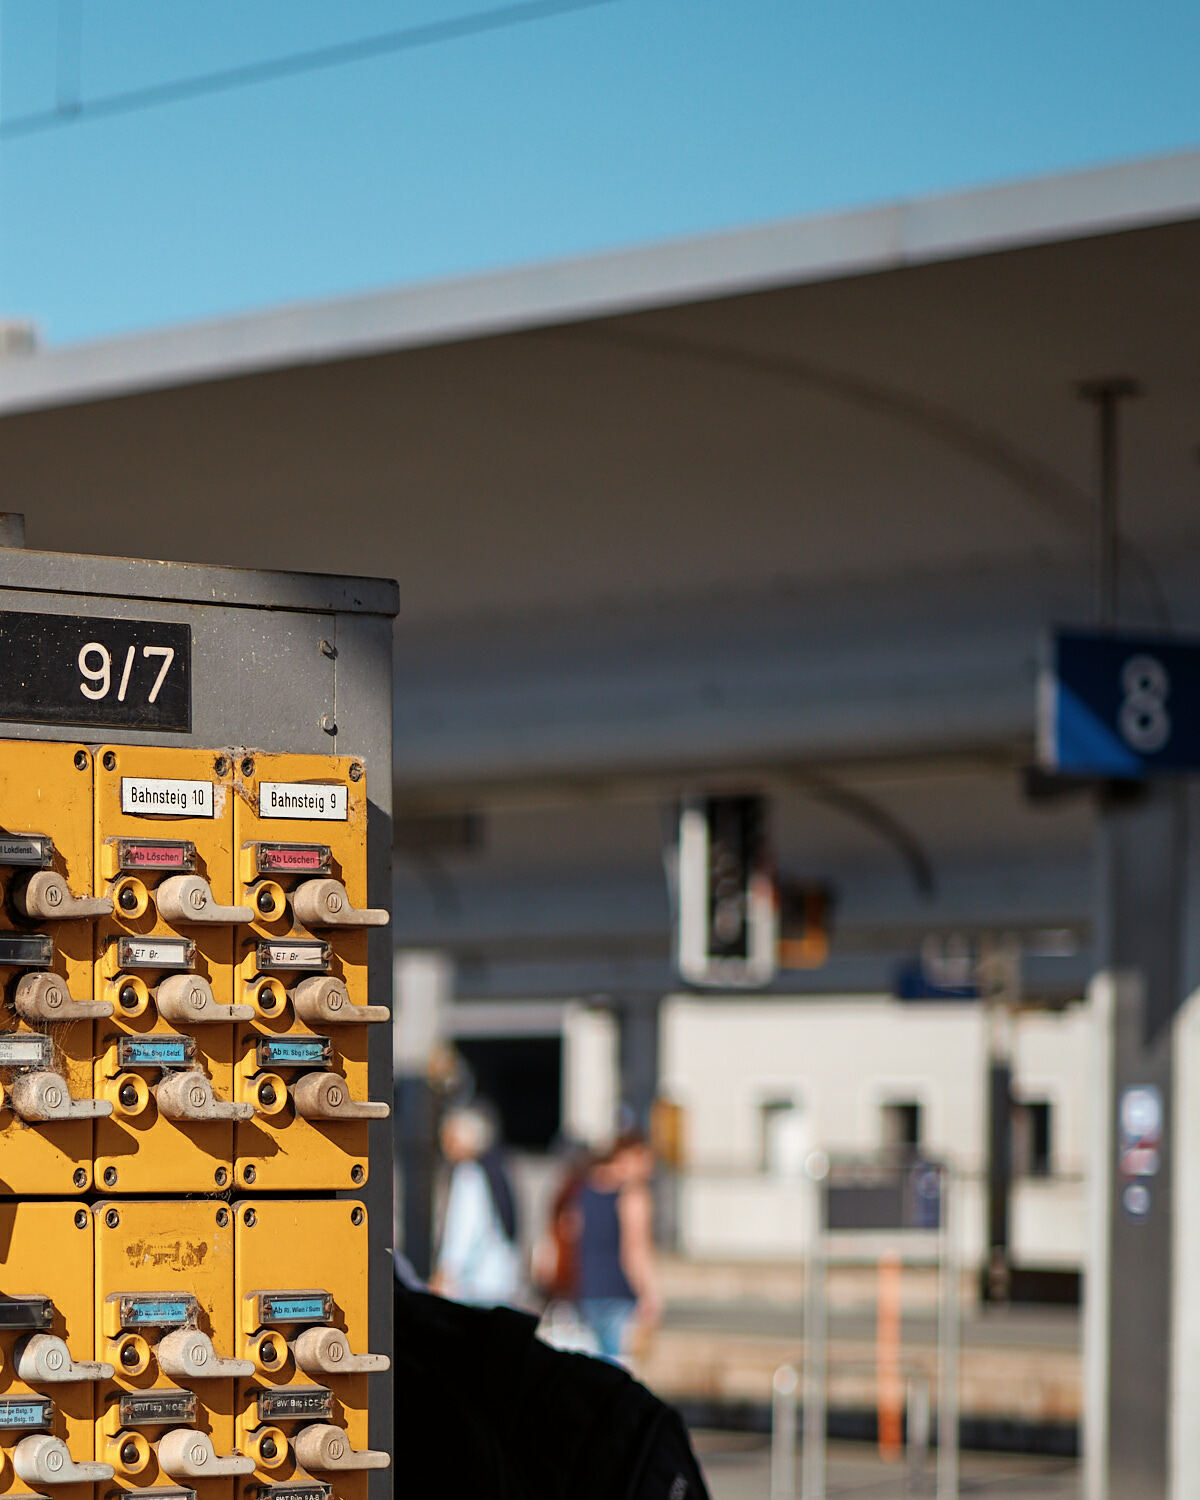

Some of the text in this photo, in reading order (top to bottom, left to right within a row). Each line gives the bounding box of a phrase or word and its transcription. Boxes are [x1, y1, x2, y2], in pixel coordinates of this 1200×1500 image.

[78, 642, 174, 703] 9/7
[1118, 652, 1171, 755] 8
[131, 786, 204, 809] Bahnsteig 10
[271, 791, 337, 813] Bahnsteig 9
[134, 851, 180, 862] Ab Löschen
[271, 854, 316, 865] Ab Löschen
[134, 949, 146, 958] ET
[275, 952, 287, 961] ET
[273, 1048, 282, 1056] Ab
[273, 1306, 283, 1314] Ab
